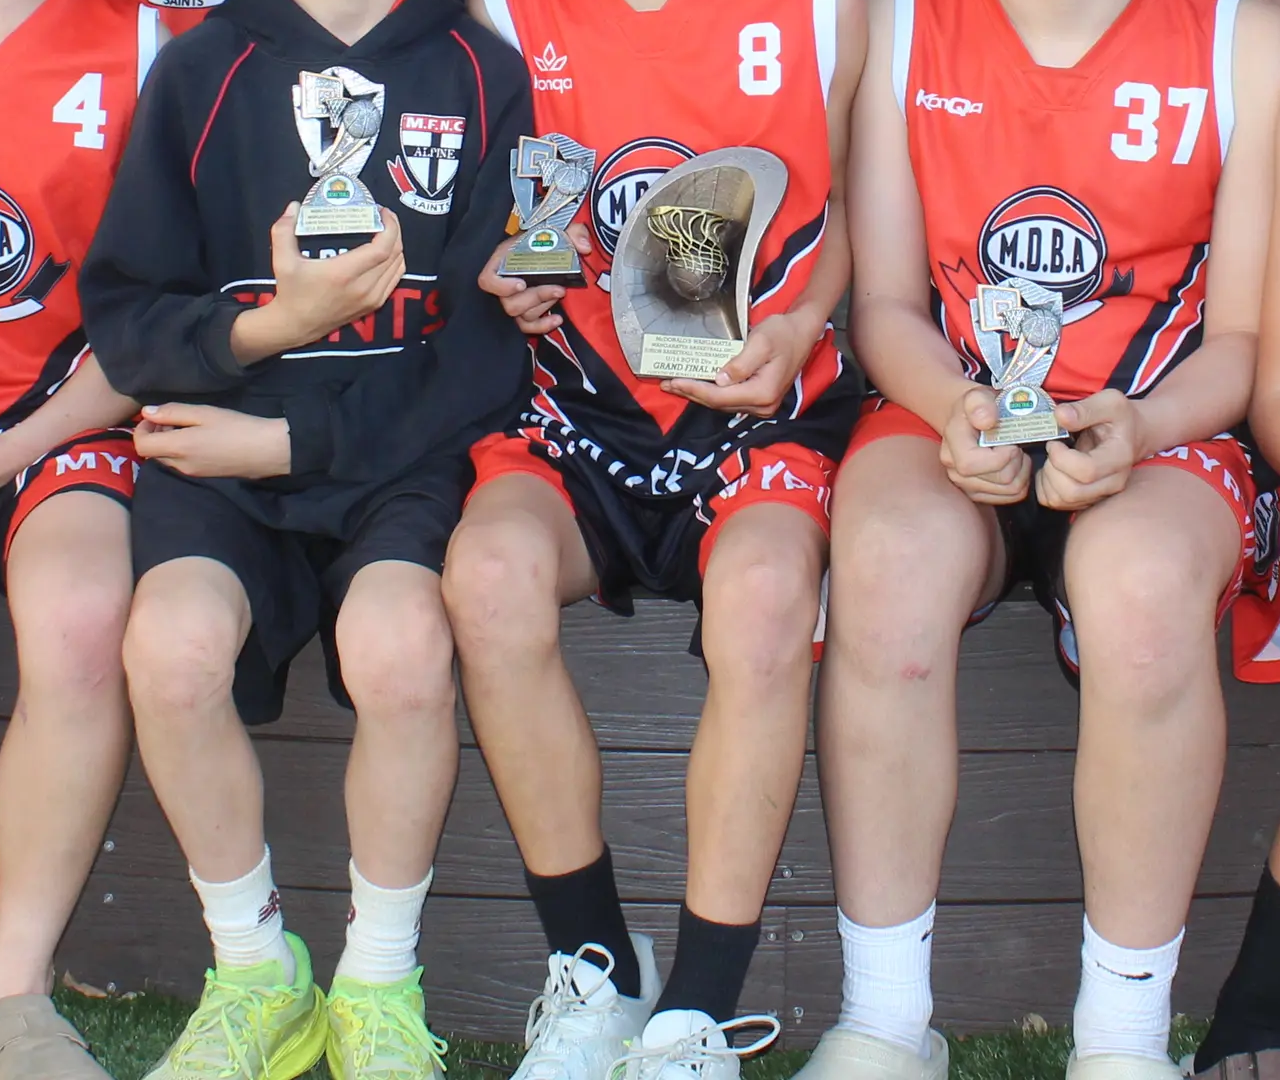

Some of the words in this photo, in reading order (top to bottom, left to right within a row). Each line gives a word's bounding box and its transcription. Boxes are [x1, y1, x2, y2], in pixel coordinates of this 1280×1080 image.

[737, 21, 782, 97] 8
[52, 73, 107, 150] 4
[1110, 81, 1209, 165] 37
[413, 146, 456, 159] ALPINE
[998, 227, 1086, 275] M.D.B.A
[652, 361, 685, 372] GRAND
[684, 363, 709, 373] FINAL
